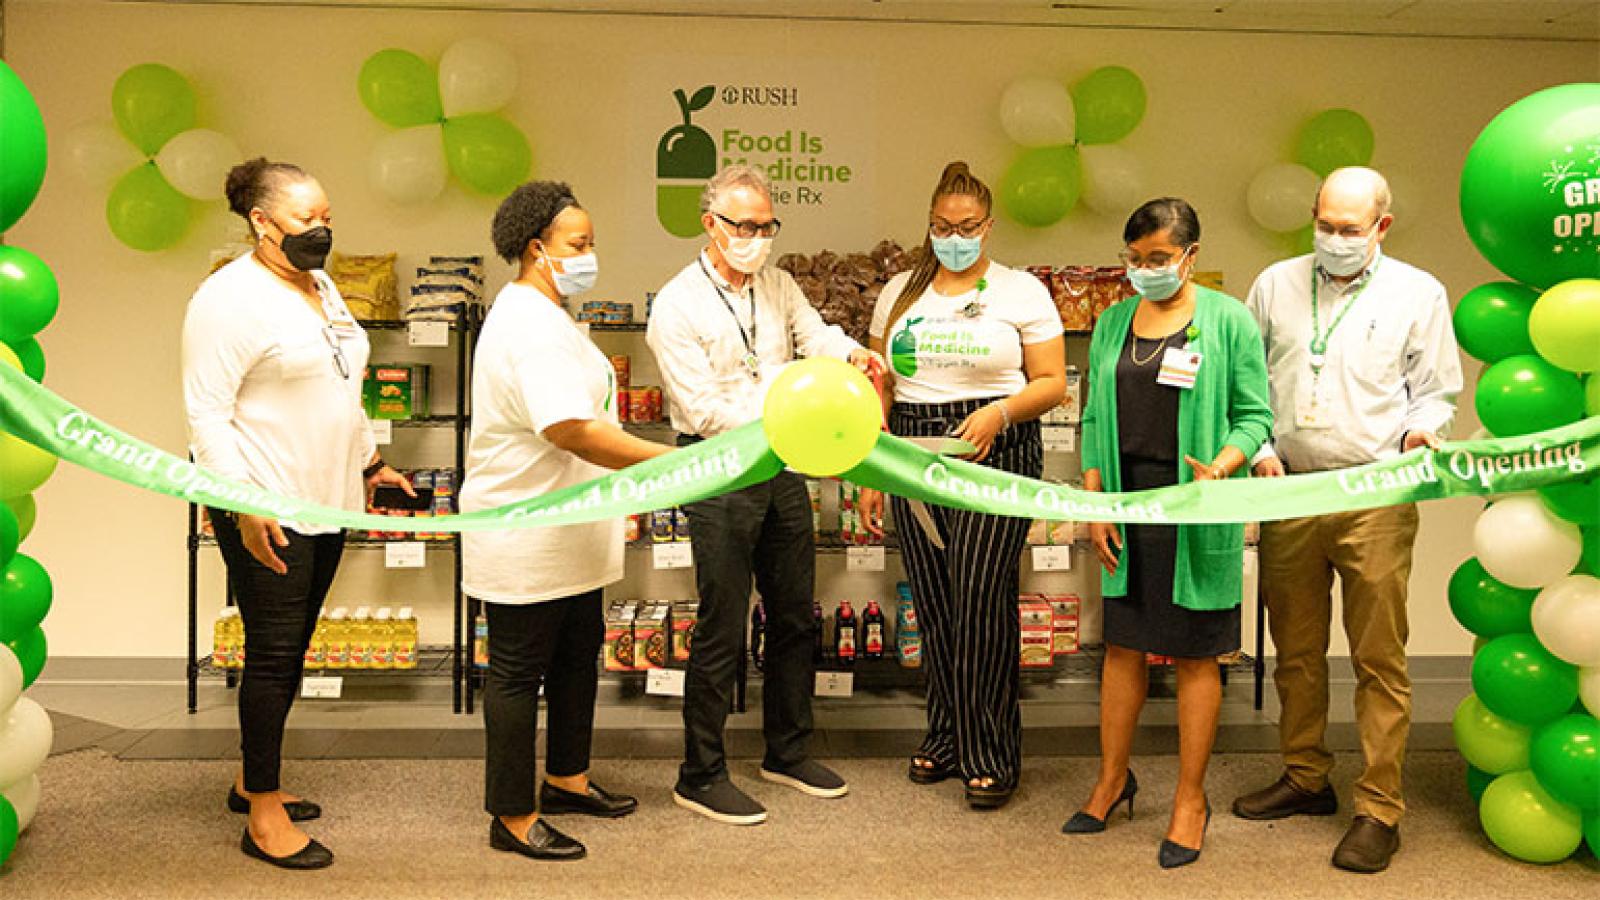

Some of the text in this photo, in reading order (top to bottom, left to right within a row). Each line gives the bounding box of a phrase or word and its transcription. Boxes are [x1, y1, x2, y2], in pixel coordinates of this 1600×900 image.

[742, 87, 798, 106] RUSH
[722, 129, 823, 154] Food Is
[797, 187, 822, 204] Rx
[919, 342, 991, 355] Medicine
[56, 413, 163, 470] Grand
[611, 446, 742, 501] Opening
[1449, 441, 1586, 487] Opening
[924, 462, 1019, 505] Grand
